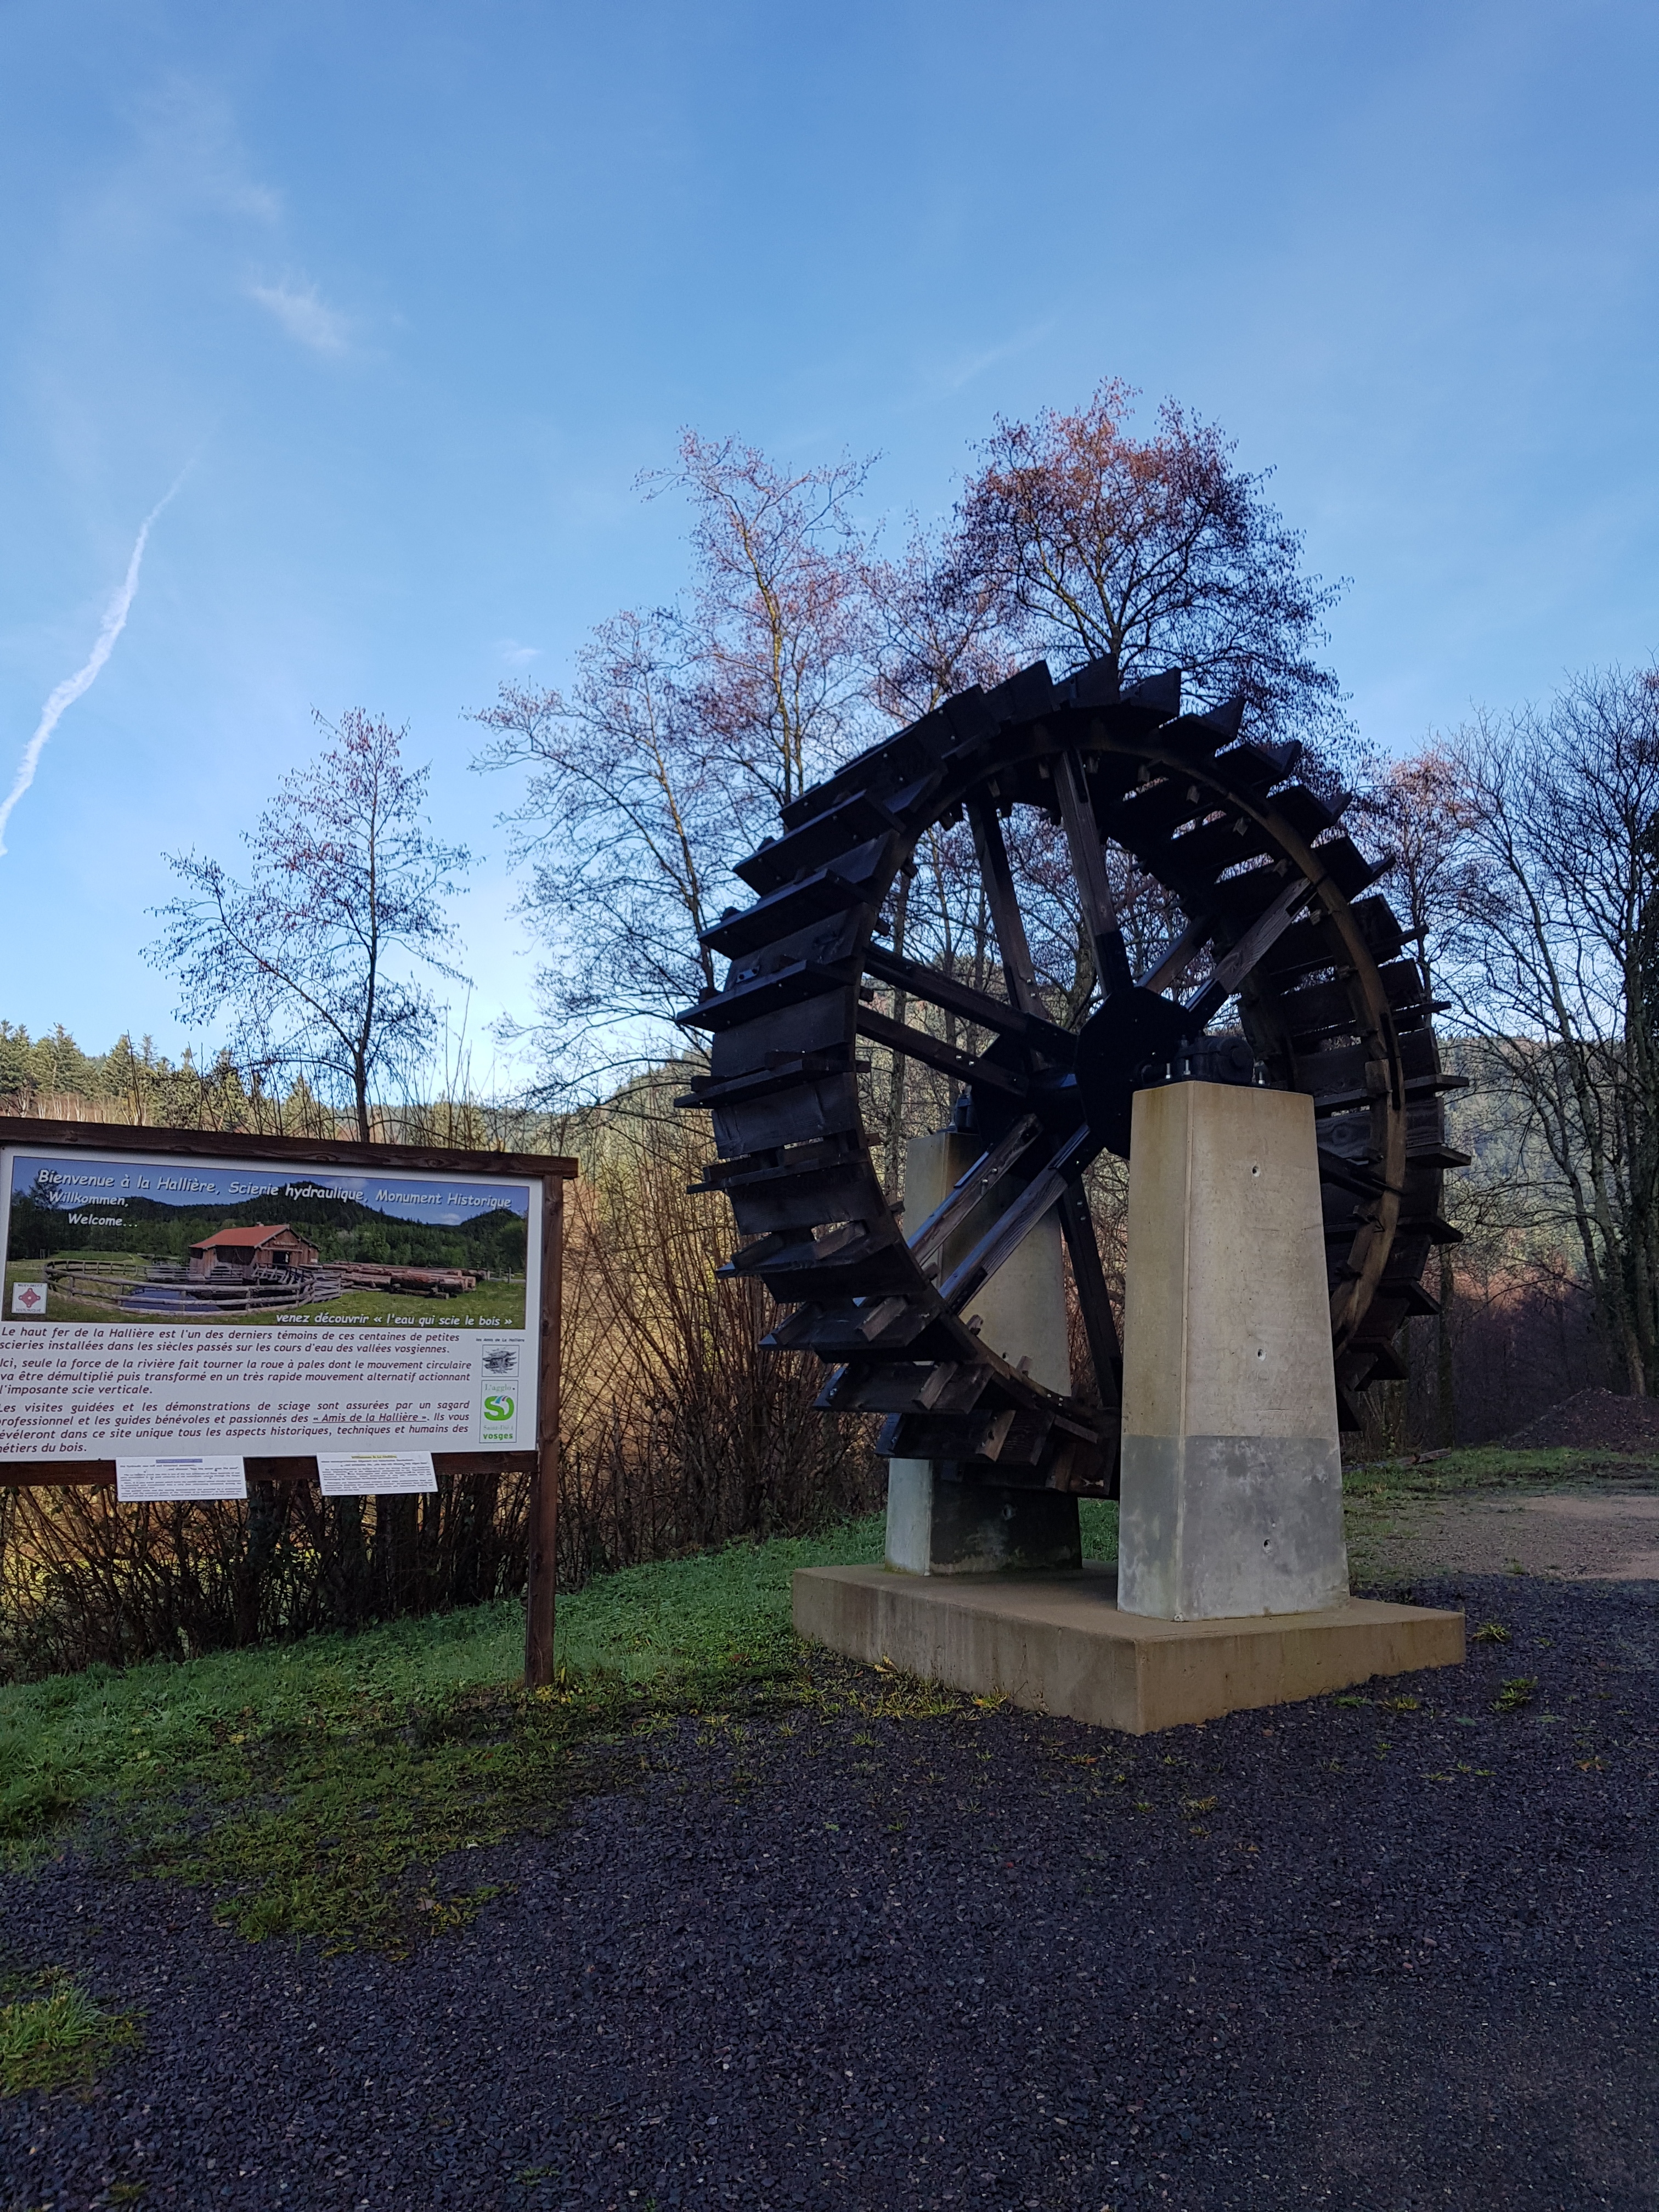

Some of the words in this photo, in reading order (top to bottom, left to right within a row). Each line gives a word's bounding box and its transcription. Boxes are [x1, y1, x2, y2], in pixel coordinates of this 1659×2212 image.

[38, 1169, 114, 1187] Bienvenue
[121, 1174, 129, 1188] à
[138, 1175, 150, 1189] la
[157, 1177, 220, 1195] Hallière,
[228, 1181, 279, 1195] Scierie
[285, 1183, 368, 1203] hydraulique,
[375, 1189, 442, 1204] Monument
[447, 1192, 511, 1209] Historique
[49, 1191, 129, 1207] Willkommen,
[68, 1213, 138, 1227] Welcome...
[276, 1314, 309, 1323] venez
[314, 1312, 369, 1323] découvrir
[387, 1313, 414, 1324] l'eau
[419, 1315, 435, 1327] qui
[439, 1316, 460, 1325] scie
[465, 1316, 475, 1325] le
[479, 1317, 500, 1325] bois
[2, 1327, 15, 1336] Le
[20, 1327, 47, 1336] haut
[52, 1328, 70, 1338] fer
[75, 1328, 88, 1337] de
[94, 1328, 104, 1337] la
[109, 1328, 154, 1338] Hallière
[181, 1330, 200, 1338] l'un
[206, 1330, 224, 1339] des
[228, 1330, 272, 1339] derniers
[278, 1330, 318, 1339] témoins
[322, 1331, 334, 1340] de
[359, 1332, 406, 1340] centaines
[410, 1333, 422, 1341] de
[426, 1333, 459, 1342] petites
[0, 1340, 44, 1349] scieries
[49, 1340, 104, 1350] installées
[108, 1341, 134, 1350] dans
[138, 1341, 153, 1350] les
[156, 1341, 193, 1351] siècles
[196, 1342, 233, 1353] passés
[256, 1343, 270, 1351] les
[305, 1343, 333, 1352] d'eau
[336, 1344, 353, 1352] des
[357, 1344, 391, 1352] vallées
[395, 1344, 449, 1355] vosgiennes.
[0, 1358, 16, 1369] Ici,
[22, 1358, 52, 1367] seule
[57, 1358, 66, 1367] la
[70, 1358, 101, 1370] force
[105, 1359, 119, 1368] de
[123, 1359, 133, 1368] la
[138, 1359, 175, 1368] rivière
[178, 1359, 199, 1370] fait
[288, 1359, 294, 1368] à
[297, 1360, 325, 1370] pales
[329, 1360, 352, 1368] dont
[426, 1361, 471, 1369] circulaire
[19, 1371, 43, 1380] être
[48, 1371, 114, 1383] démultiplié
[117, 1372, 140, 1383] puis
[145, 1372, 206, 1383] transformé
[244, 1372, 264, 1381] très
[268, 1372, 302, 1383] rapide
[367, 1372, 416, 1383] alternatif
[419, 1372, 470, 1380] actionnant
[0, 1385, 68, 1396] l'imposante
[72, 1385, 94, 1394] scie
[99, 1385, 152, 1393] verticale.
[25, 1403, 63, 1412] visites
[71, 1402, 114, 1414] guidées
[142, 1402, 157, 1411] les
[166, 1402, 250, 1411] démonstrations
[258, 1402, 270, 1410] de
[278, 1401, 310, 1412] sciage
[346, 1401, 389, 1409] assurées
[396, 1403, 413, 1411] par
[437, 1401, 470, 1410] sagard
[0, 1416, 74, 1427] rofessionnel
[78, 1417, 90, 1425] et
[95, 1416, 110, 1425] les
[115, 1415, 151, 1426] guides
[155, 1414, 210, 1424] bénévoles
[229, 1413, 287, 1425] passionnés
[291, 1414, 308, 1422] des
[321, 1413, 346, 1422] Amis
[379, 1413, 418, 1421] Hallière
[0, 1429, 55, 1439] évéleront
[61, 1430, 87, 1438] dans
[110, 1429, 131, 1437] site
[136, 1428, 173, 1439] unique
[206, 1427, 221, 1436] les
[226, 1428, 266, 1438] aspects
[270, 1426, 331, 1437] historiques,
[337, 1425, 391, 1436] techniques
[409, 1424, 448, 1432] humains
[42, 1443, 56, 1452] du
[59, 1442, 86, 1452] bois.
